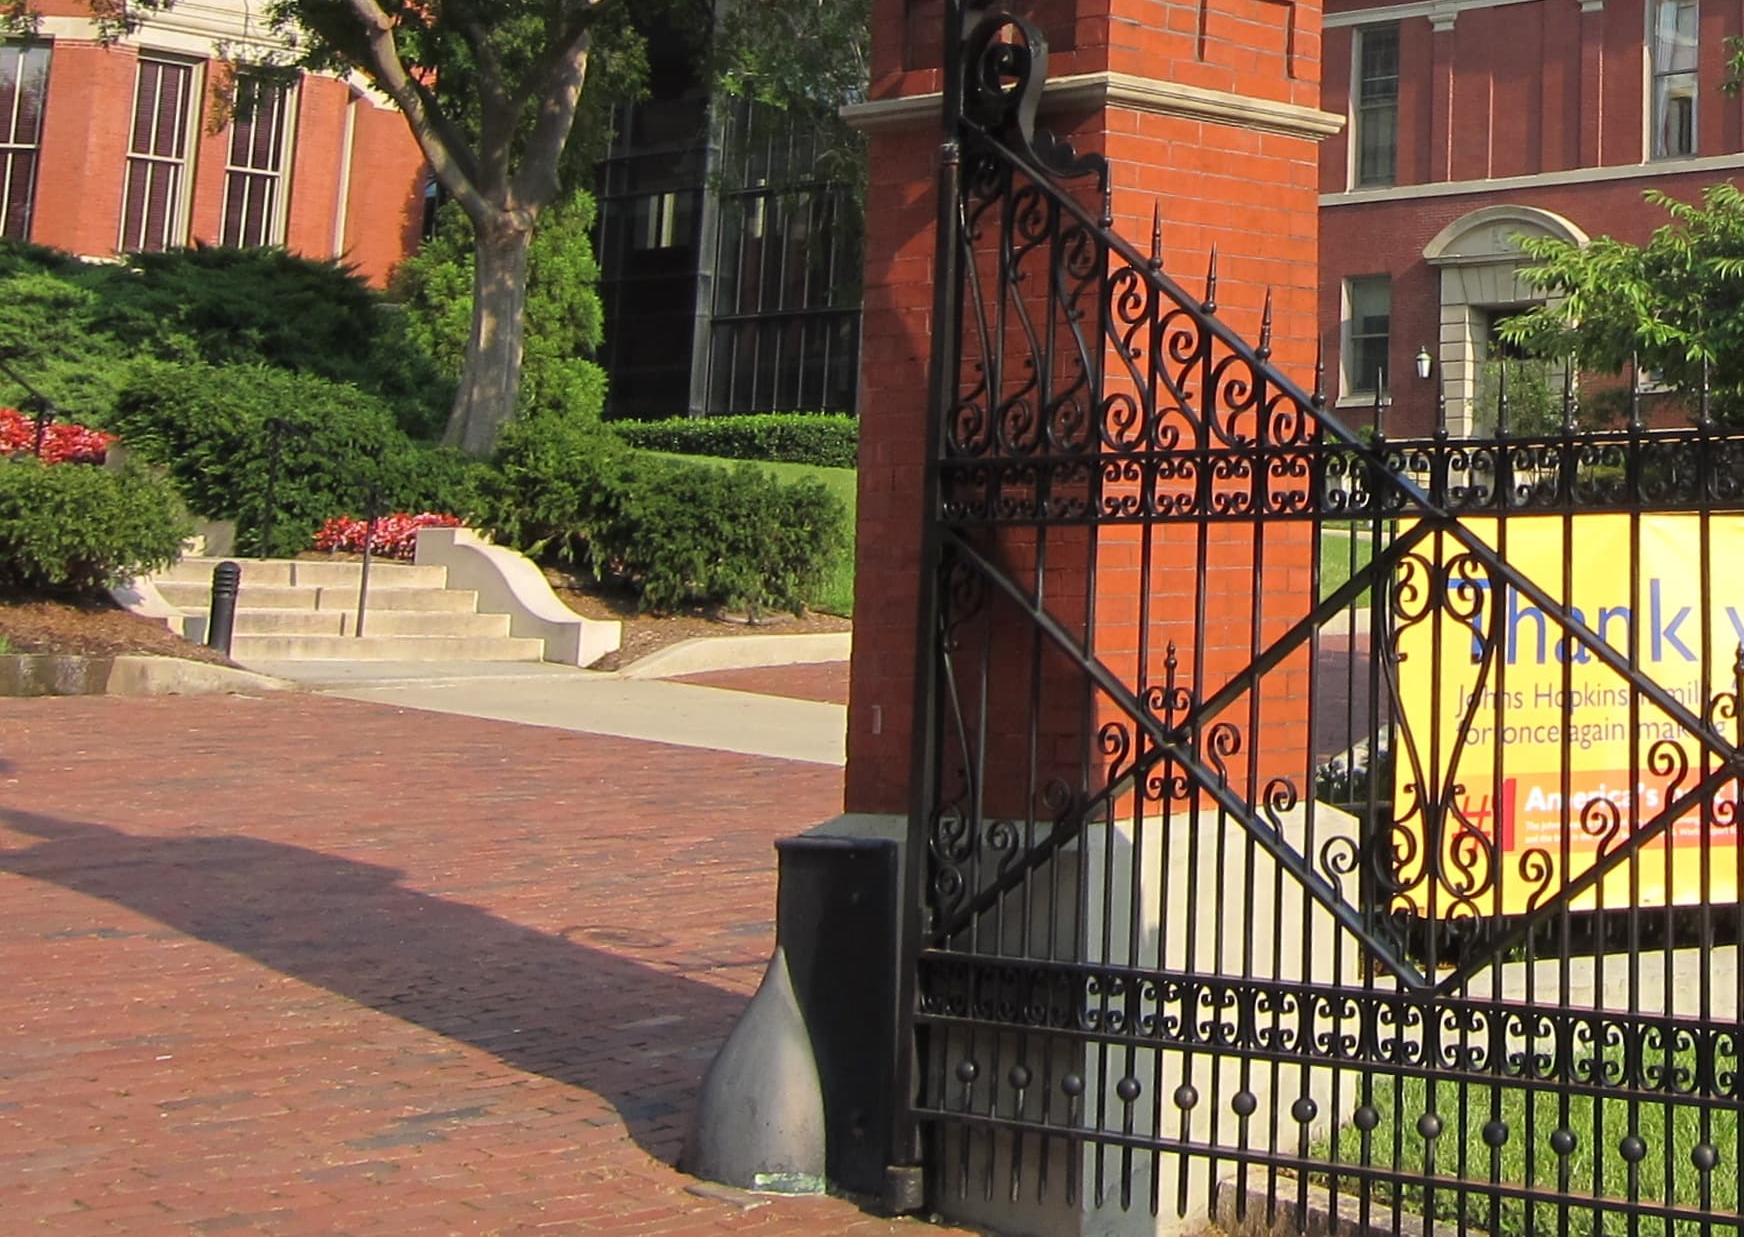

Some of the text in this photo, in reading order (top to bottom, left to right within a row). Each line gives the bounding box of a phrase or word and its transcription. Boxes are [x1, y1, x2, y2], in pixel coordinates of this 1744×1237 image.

[1446, 577, 1698, 665] Thank
[1533, 680, 1629, 716] Hopkins
[1503, 724, 1560, 745] once
[1568, 716, 1626, 750] again
